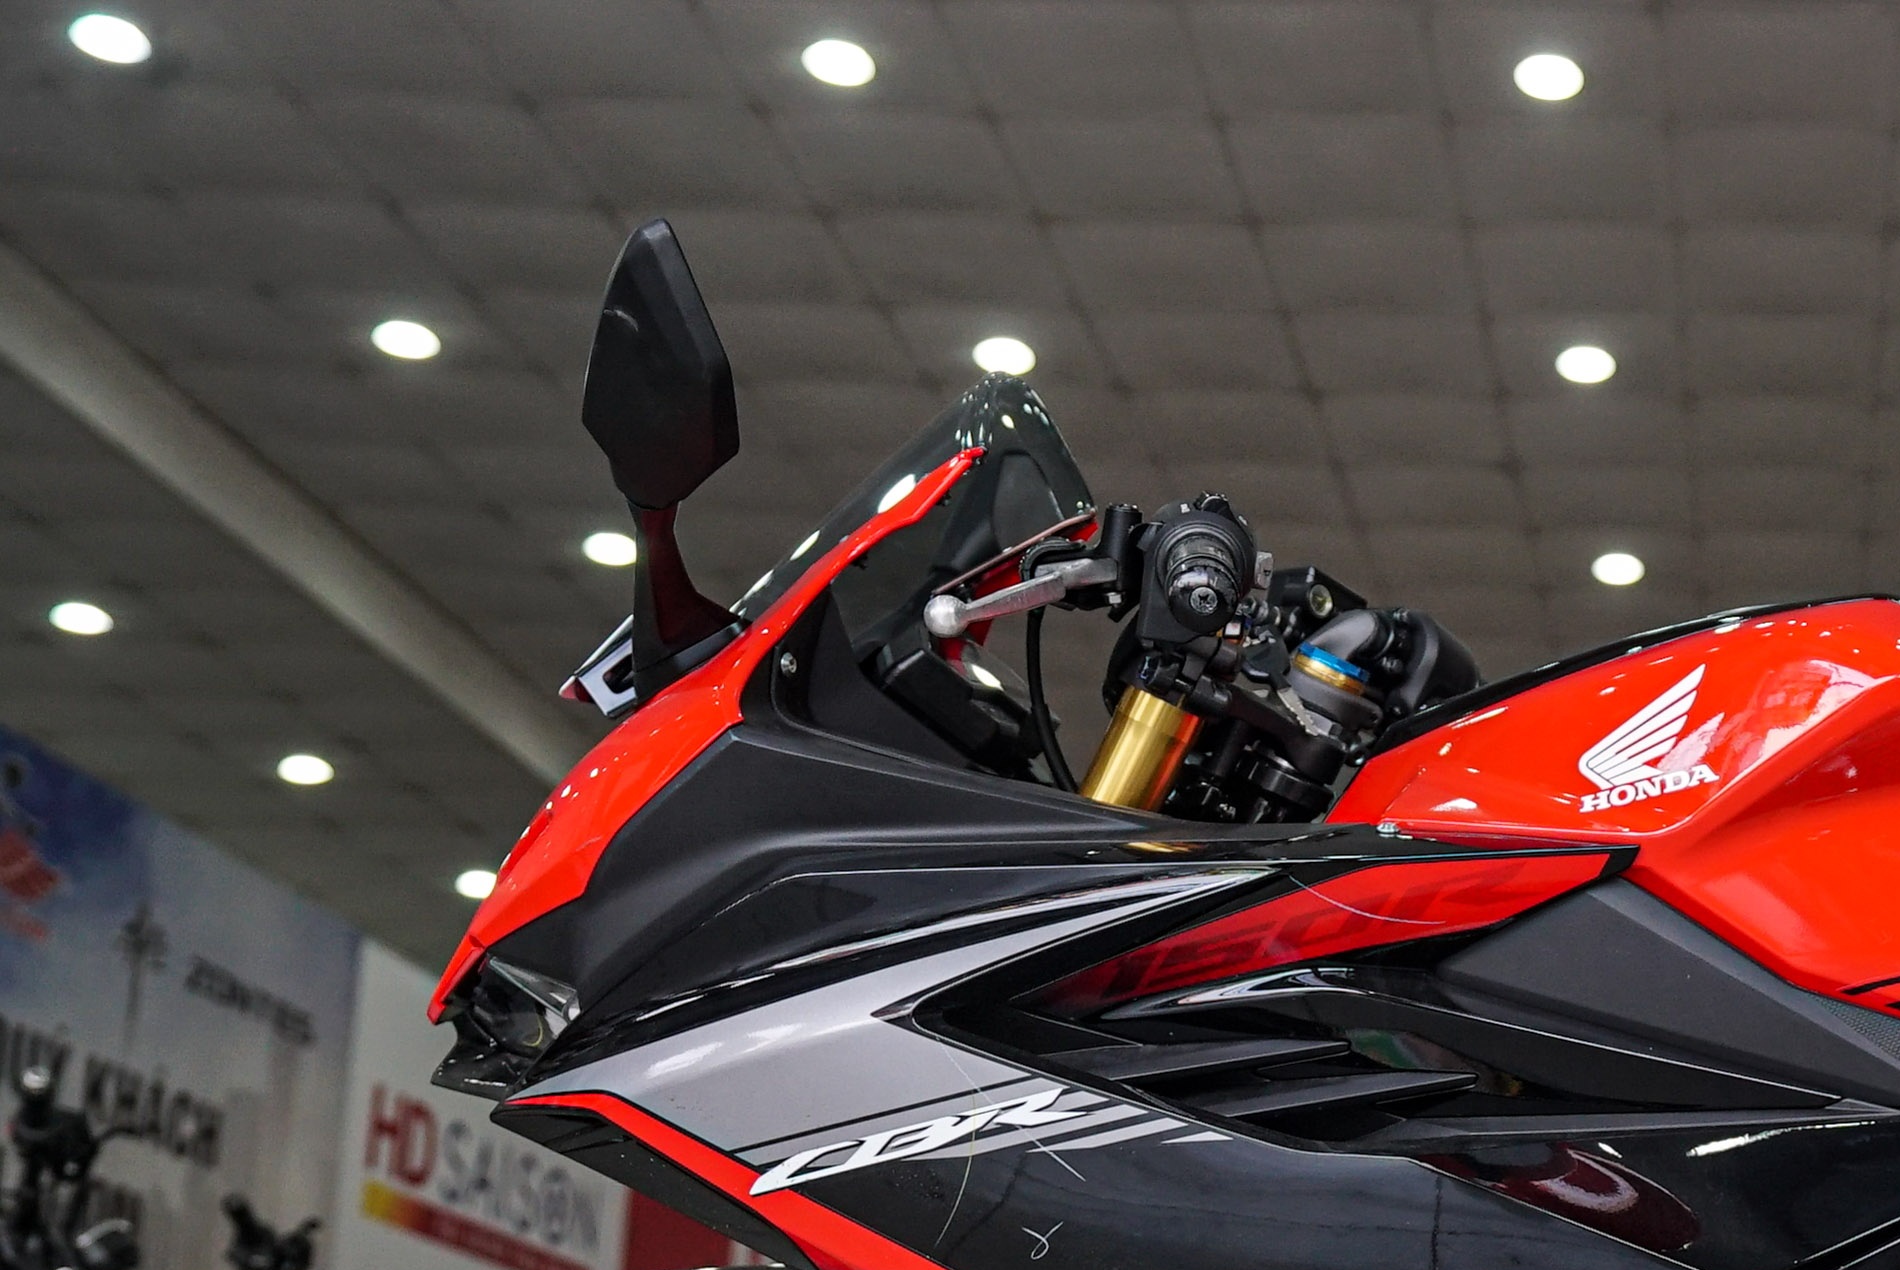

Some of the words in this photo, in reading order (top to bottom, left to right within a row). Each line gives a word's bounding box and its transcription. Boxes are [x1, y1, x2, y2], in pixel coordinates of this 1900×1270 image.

[1579, 763, 1720, 813] HONDA
[366, 1081, 438, 1186] HD
[749, 1087, 1090, 1197] CBR
